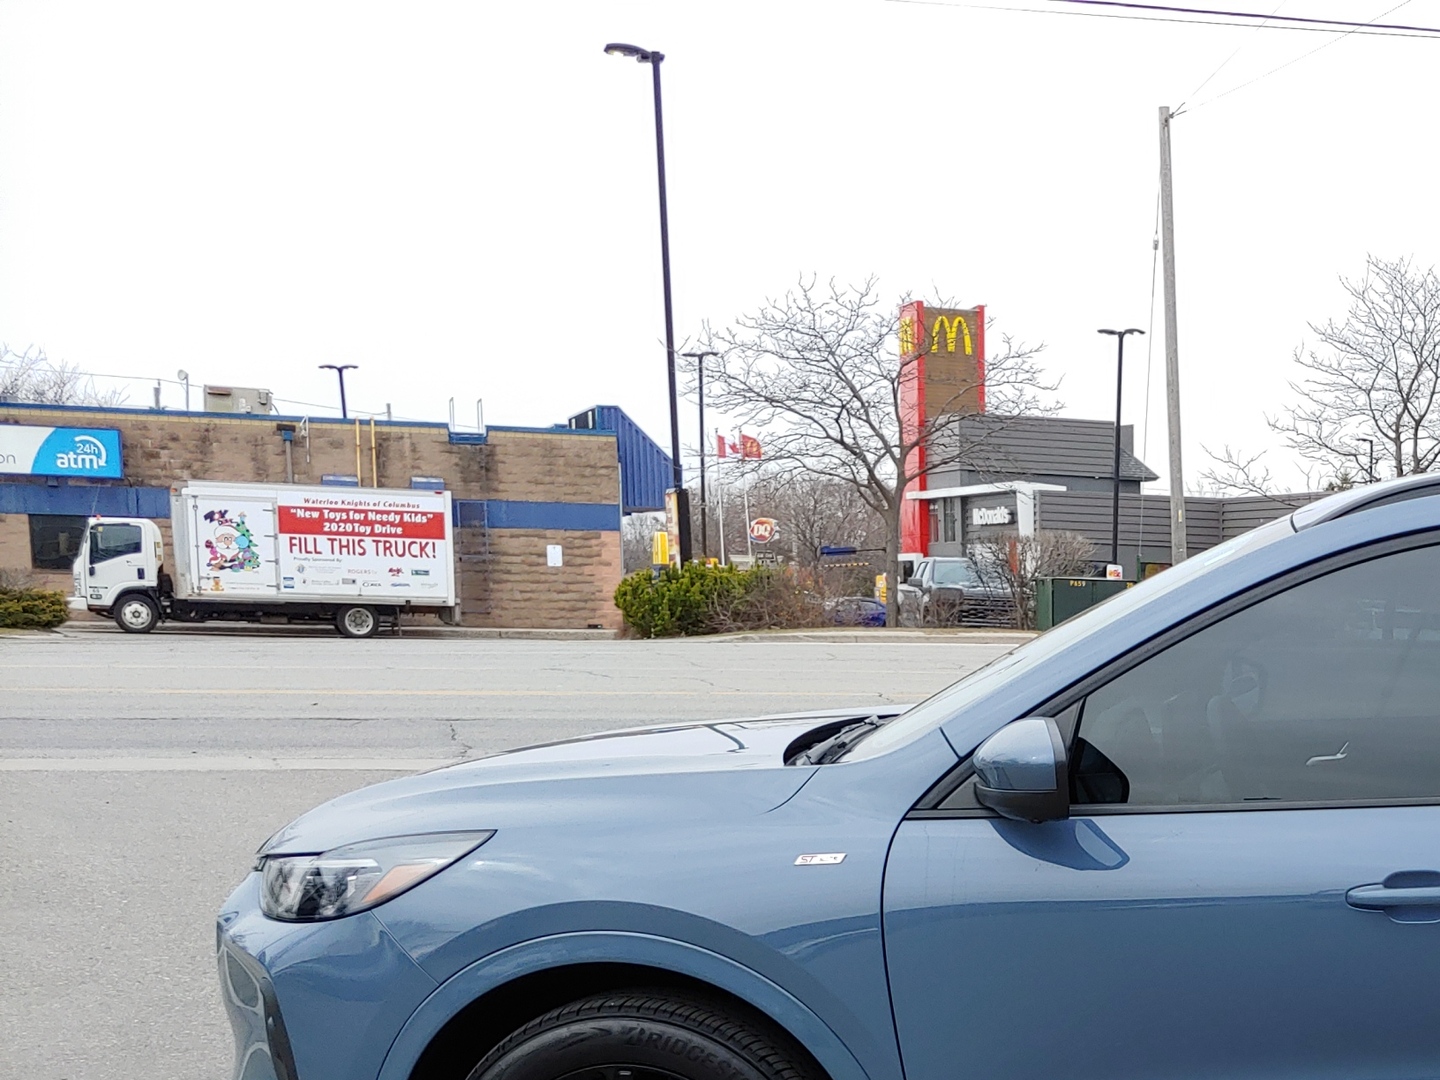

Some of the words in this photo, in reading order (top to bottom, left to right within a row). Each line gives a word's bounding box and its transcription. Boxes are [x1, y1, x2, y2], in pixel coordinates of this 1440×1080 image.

[76, 443, 99, 454] 24h
[56, 451, 99, 470] atm
[303, 497, 339, 506] Waterloo
[341, 499, 370, 508] Knights
[383, 501, 420, 509] Columbus
[323, 509, 347, 520] Toys
[349, 510, 365, 521] for
[367, 511, 401, 524] Needy
[374, 523, 403, 535] Drive
[754, 523, 771, 537] DQ
[288, 536, 323, 555] FILL
[327, 537, 367, 556] THIS
[372, 539, 437, 559] TRUCK!
[799, 855, 818, 863] ST
